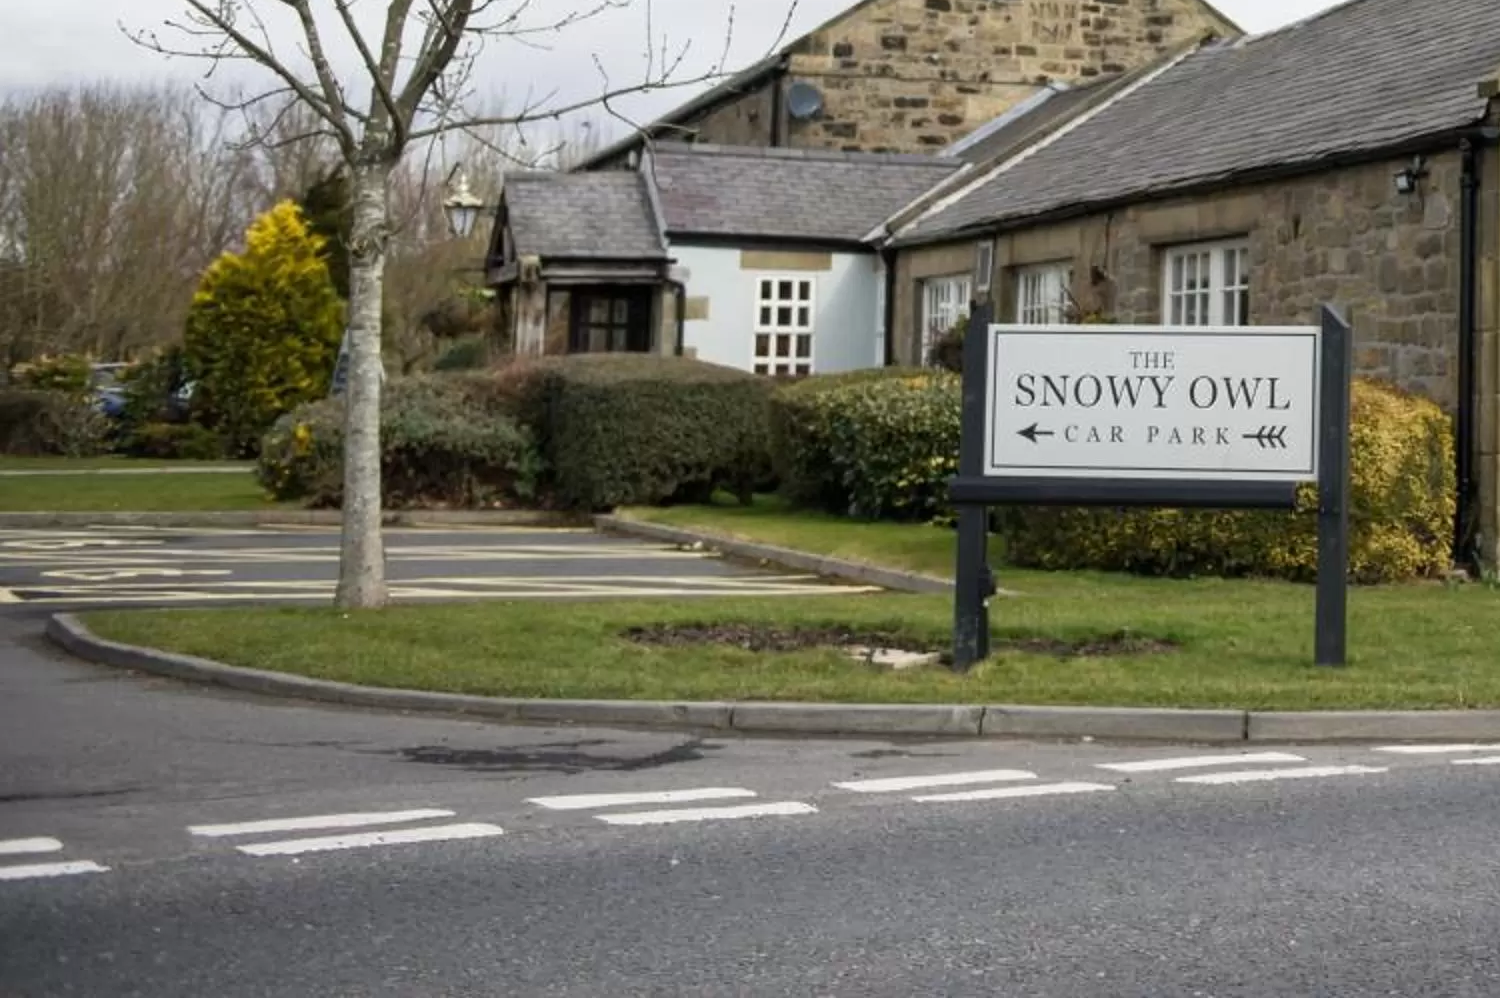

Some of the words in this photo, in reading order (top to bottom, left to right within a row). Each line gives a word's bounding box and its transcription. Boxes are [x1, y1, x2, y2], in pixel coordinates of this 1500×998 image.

[1129, 351, 1176, 370] THE
[1015, 373, 1175, 408] SNOWY
[1189, 375, 1291, 410] OWL
[1064, 425, 1125, 443] CAR
[1147, 426, 1231, 445] PARK
